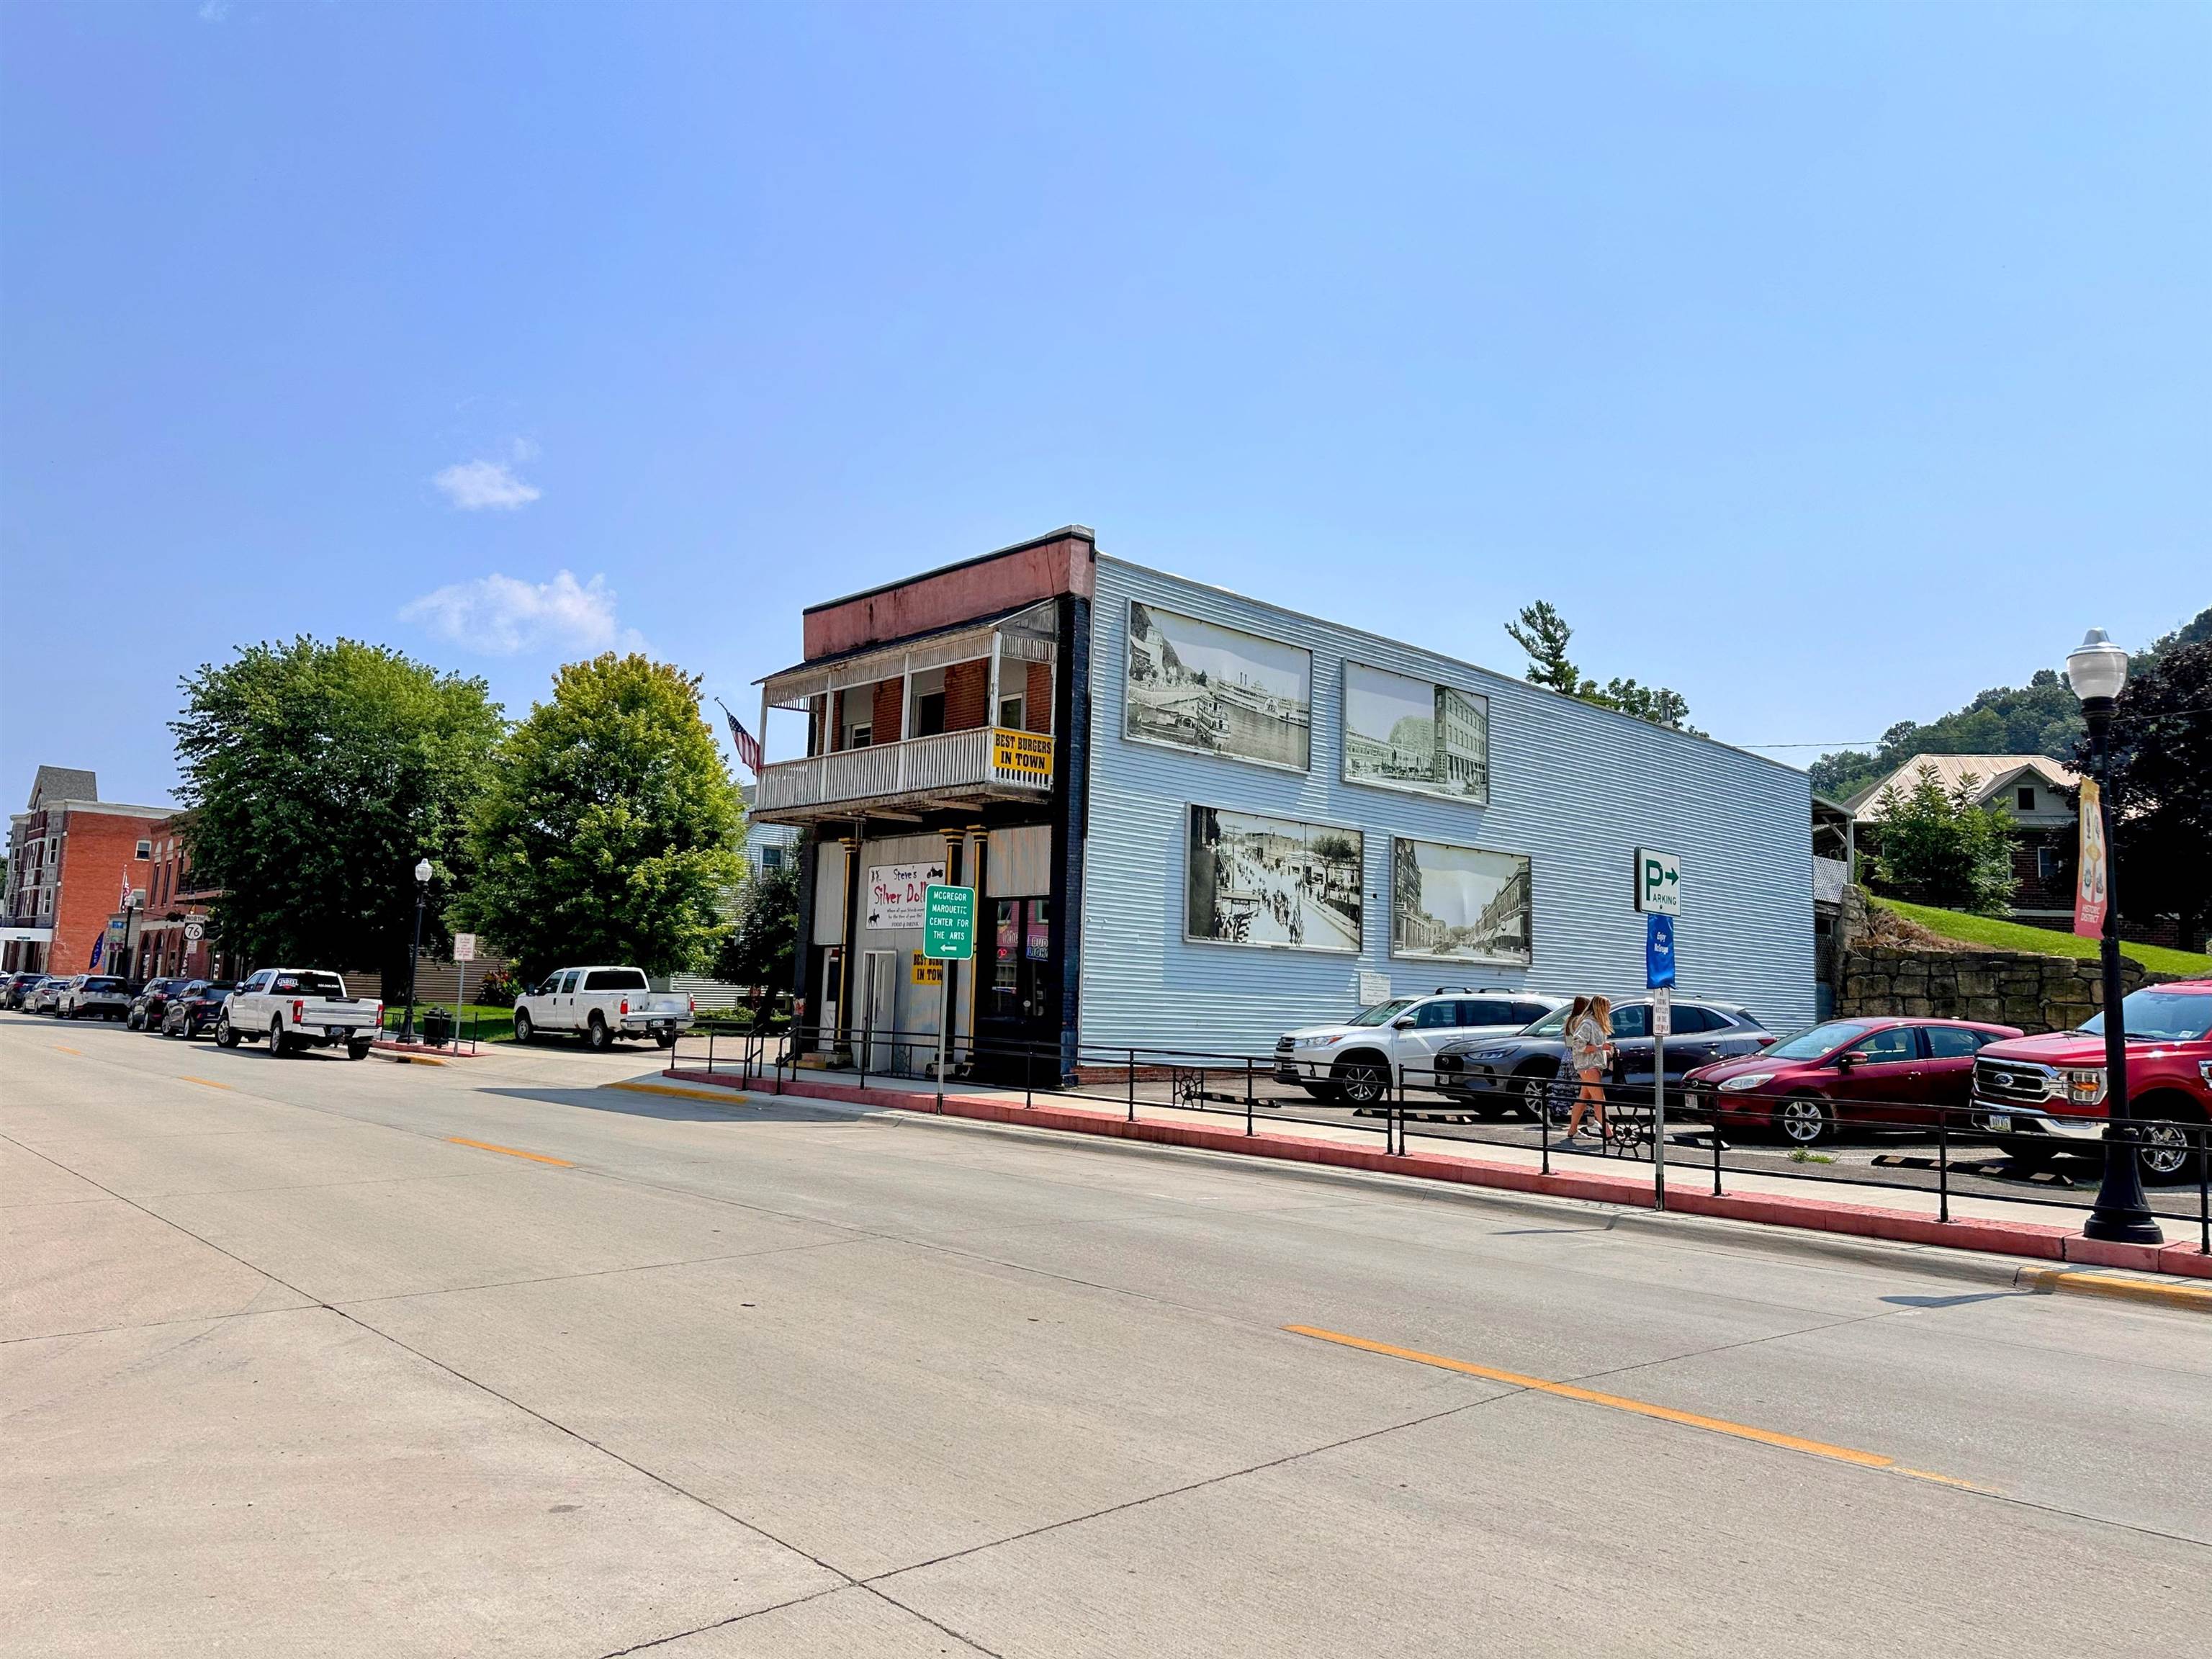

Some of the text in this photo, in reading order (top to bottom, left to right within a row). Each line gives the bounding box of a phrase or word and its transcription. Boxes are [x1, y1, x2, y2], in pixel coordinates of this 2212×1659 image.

[995, 733, 1052, 755] BEST BURGERS
[1000, 750, 1046, 769] IN TOWN
[893, 866, 917, 881] Steve's
[874, 881, 926, 905] Silver Doll
[933, 891, 967, 902] MCGREGOR
[2082, 904, 2101, 915] HISTORIC
[930, 917, 969, 927] CENTER FOR
[2081, 912, 2100, 923] DISTRICT
[188, 927, 200, 937] 76
[933, 930, 965, 940] THE ARTS
[1031, 937, 1048, 948] BUD
[917, 968, 943, 980] IN TOW
